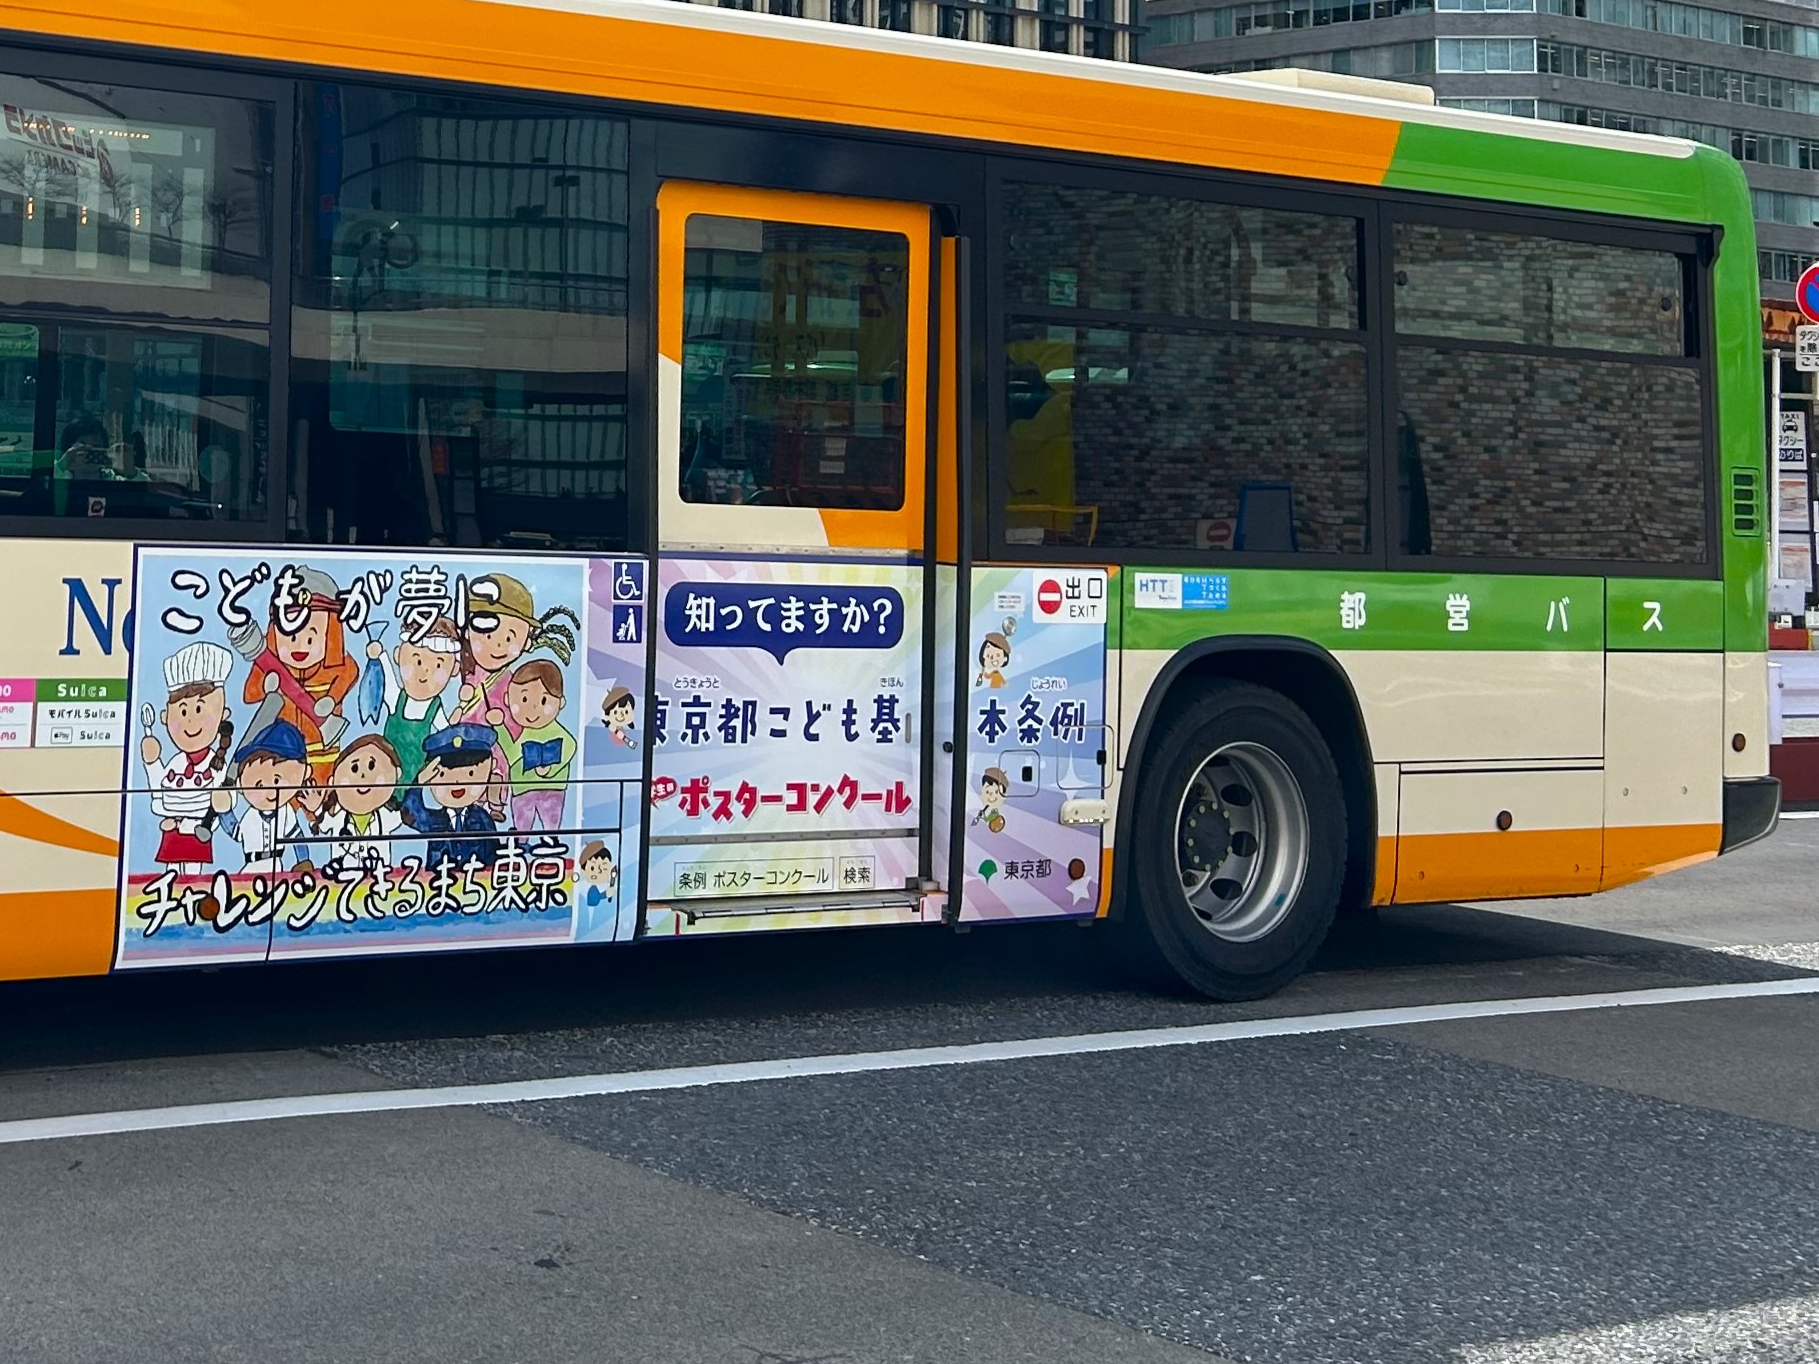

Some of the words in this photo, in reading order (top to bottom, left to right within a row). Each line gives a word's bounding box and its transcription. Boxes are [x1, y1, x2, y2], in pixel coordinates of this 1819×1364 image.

[1065, 576, 1103, 600] 出口
[1139, 579, 1168, 593] HTT
[160, 561, 502, 643] こどもが夢に
[1069, 604, 1097, 618] EXIT
[1339, 590, 1663, 632] 都営バス
[57, 683, 107, 698] Suica
[674, 677, 720, 688] とうきょうと
[880, 677, 904, 687] きほん
[1031, 677, 1068, 691] じょうれい
[977, 693, 1086, 745] 本条例
[79, 731, 111, 740] Suica
[678, 774, 912, 822] ポスターコンクール
[679, 872, 707, 890] 条例
[713, 868, 829, 889] ポスターコンクール
[844, 867, 871, 884] 検索
[1003, 859, 1052, 880] 東京都
[136, 838, 570, 937] チャレンジできるまち東京
